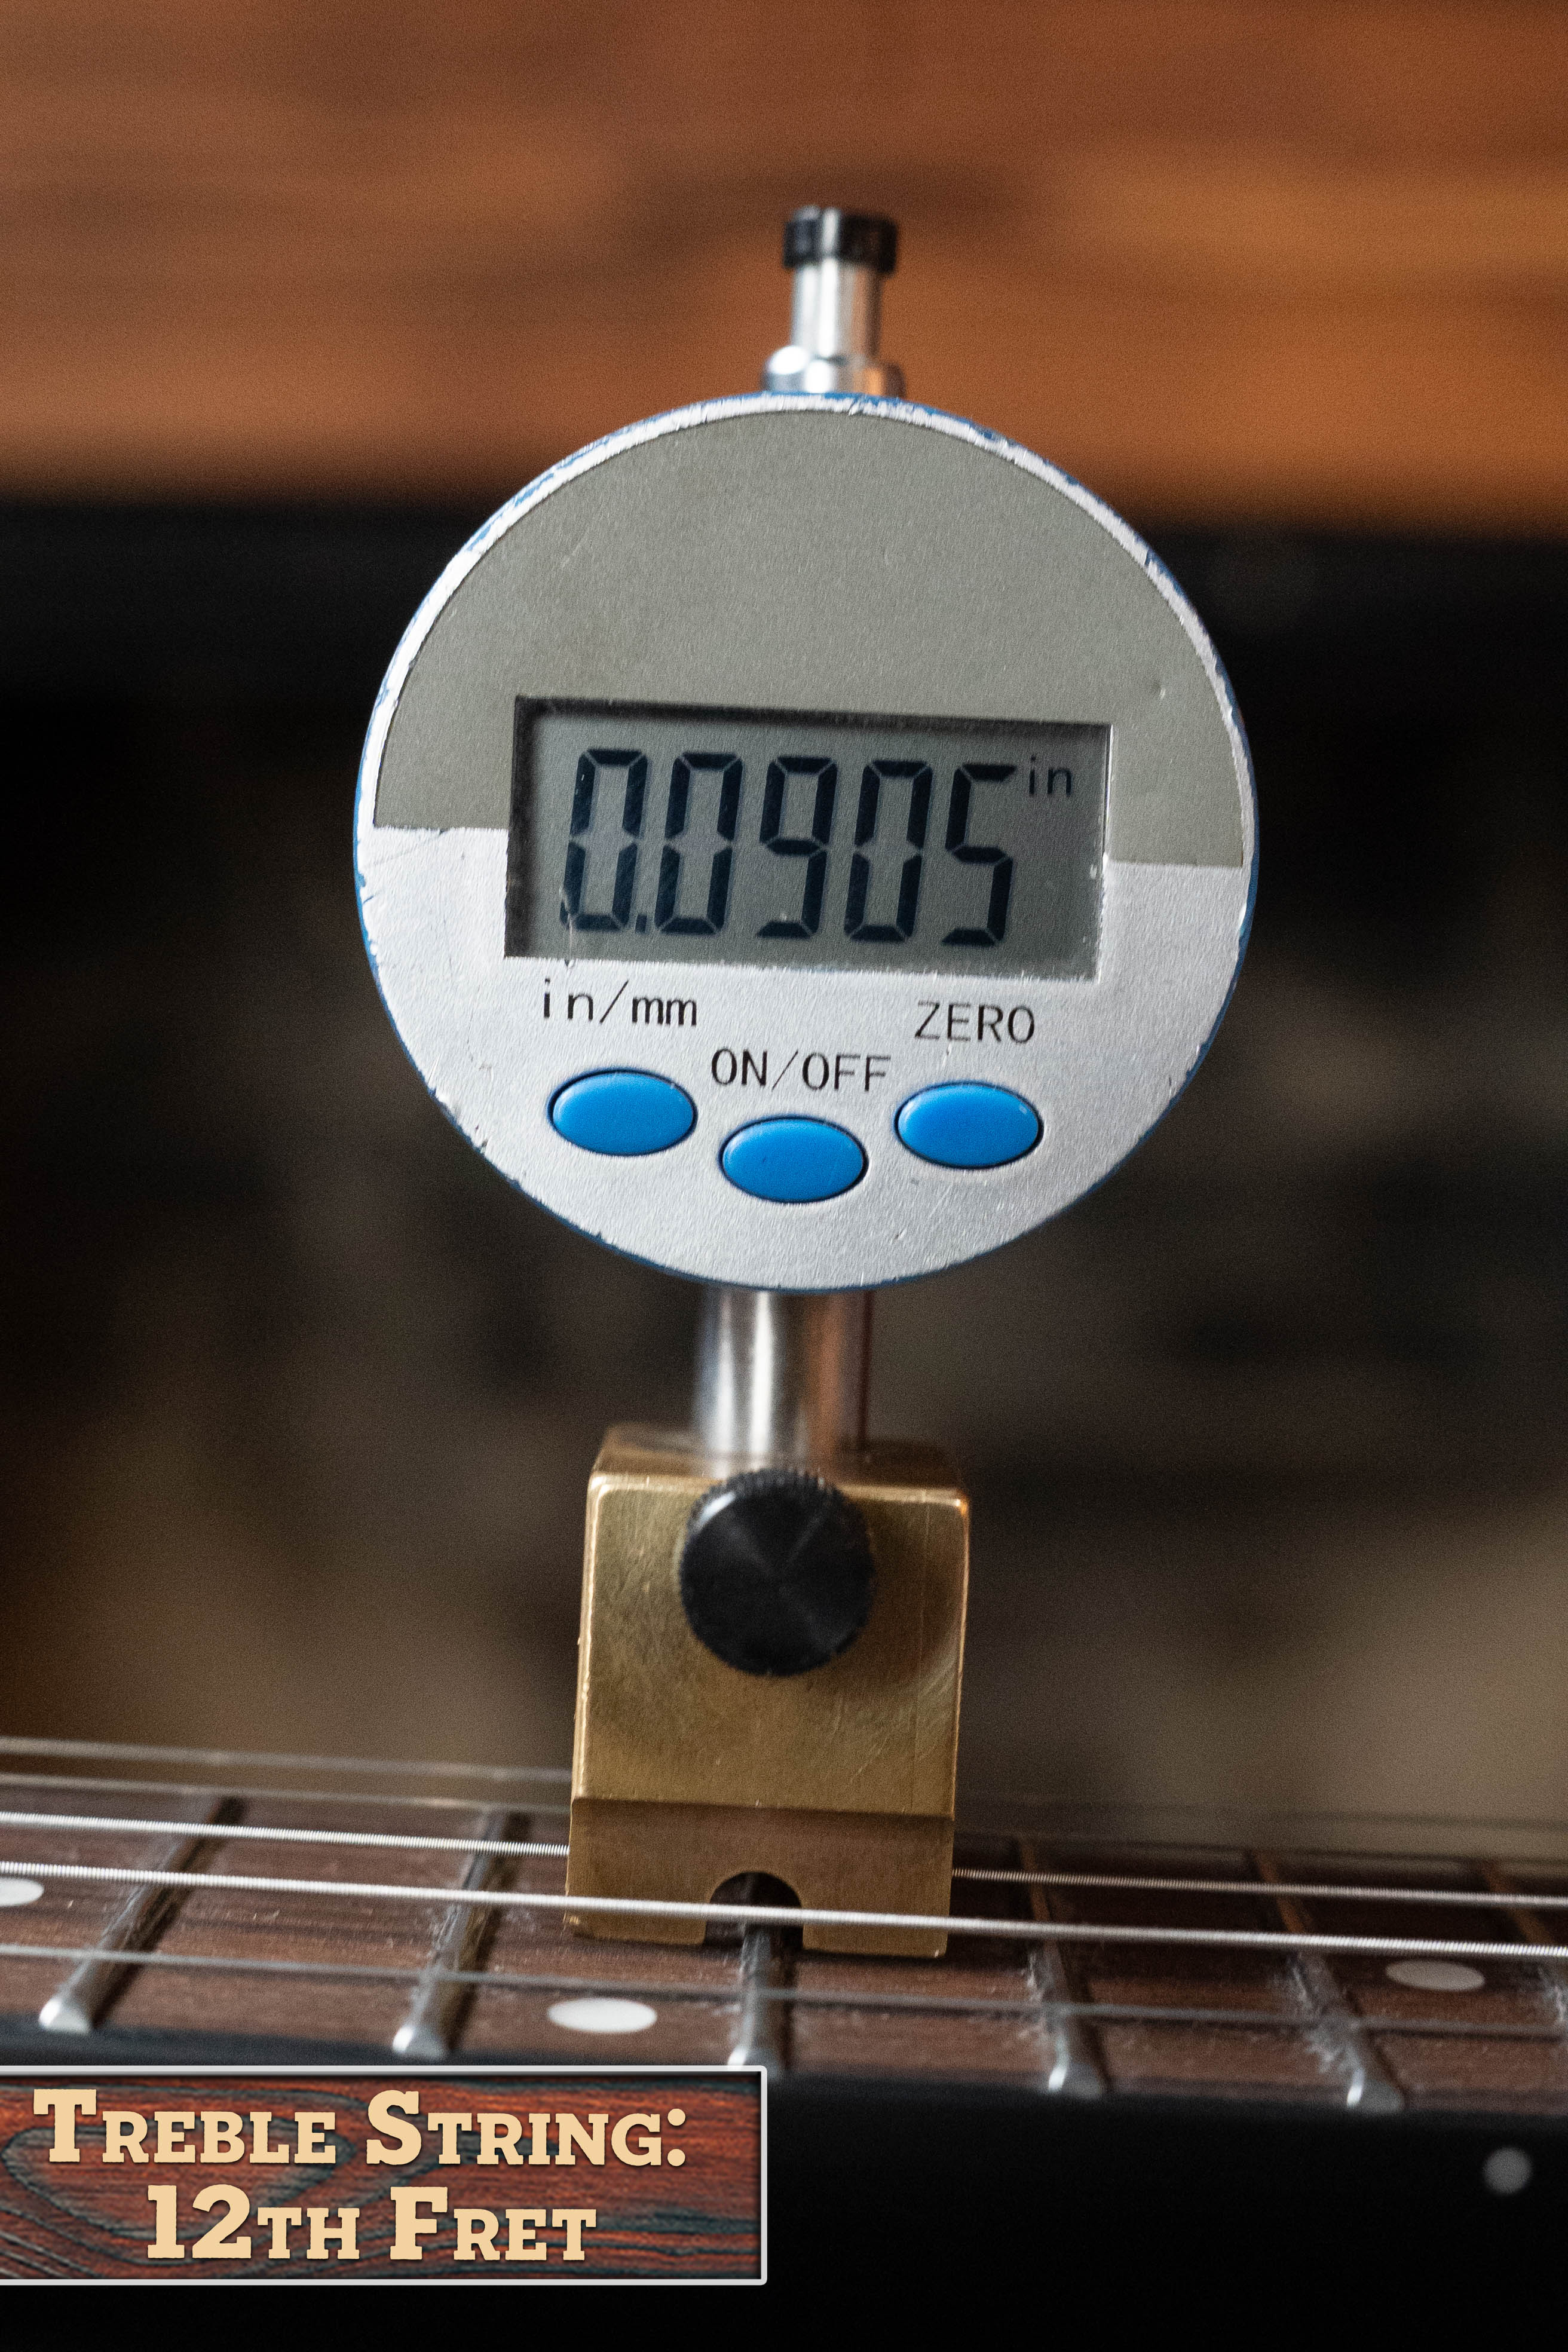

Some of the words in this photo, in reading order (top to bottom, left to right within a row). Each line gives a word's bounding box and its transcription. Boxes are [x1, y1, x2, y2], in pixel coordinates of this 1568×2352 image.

[559, 748, 1016, 947] 0.0905
[1028, 755, 1073, 798] in
[543, 978, 697, 1027] in/mm
[914, 1000, 1036, 1044] ZERO
[711, 1048, 892, 1092] ON/OFF
